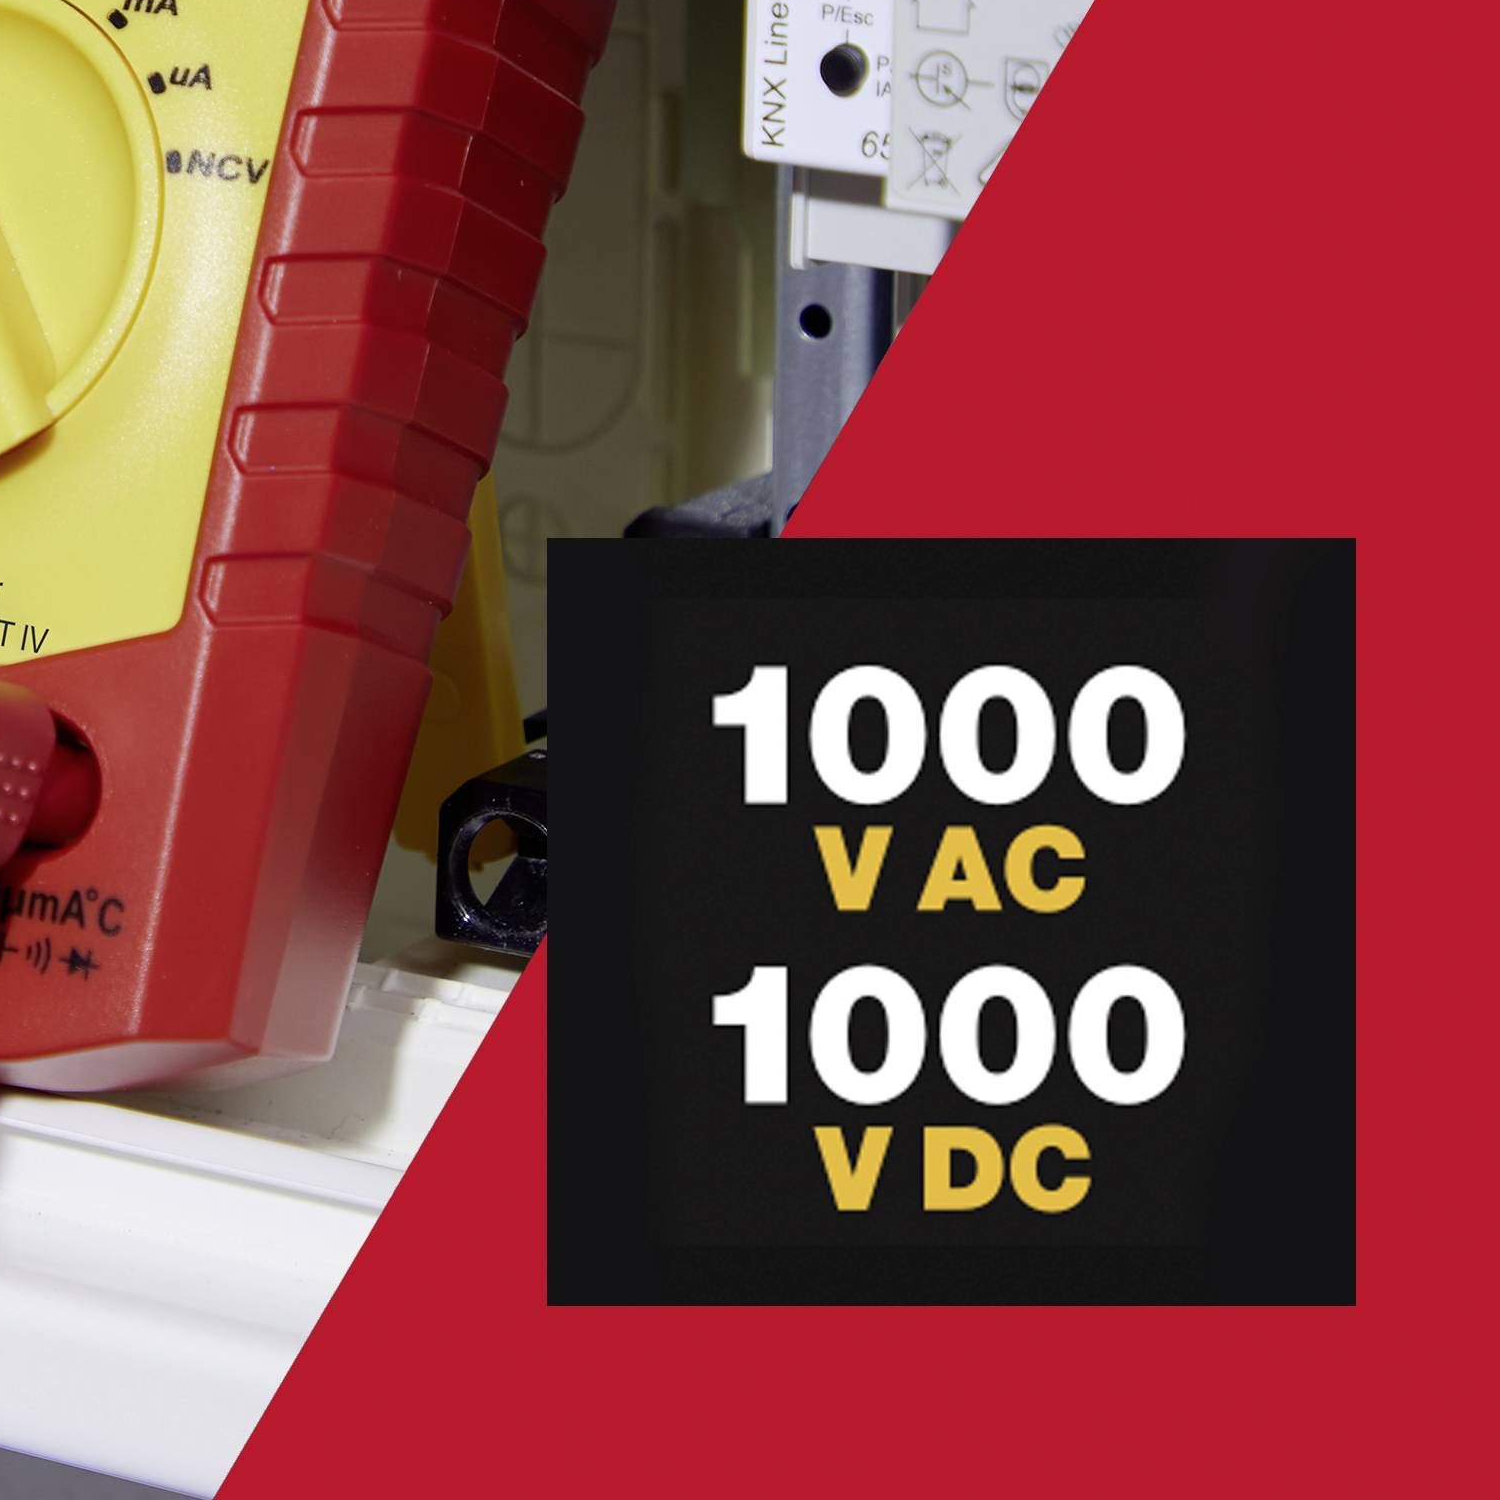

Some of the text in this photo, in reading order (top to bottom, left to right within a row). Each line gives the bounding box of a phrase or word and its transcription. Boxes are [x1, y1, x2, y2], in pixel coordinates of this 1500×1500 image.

[821, 3, 875, 27] P/Esc
[761, 77, 788, 148] KNX
[186, 149, 270, 184] NCV
[21, 624, 49, 654] IV
